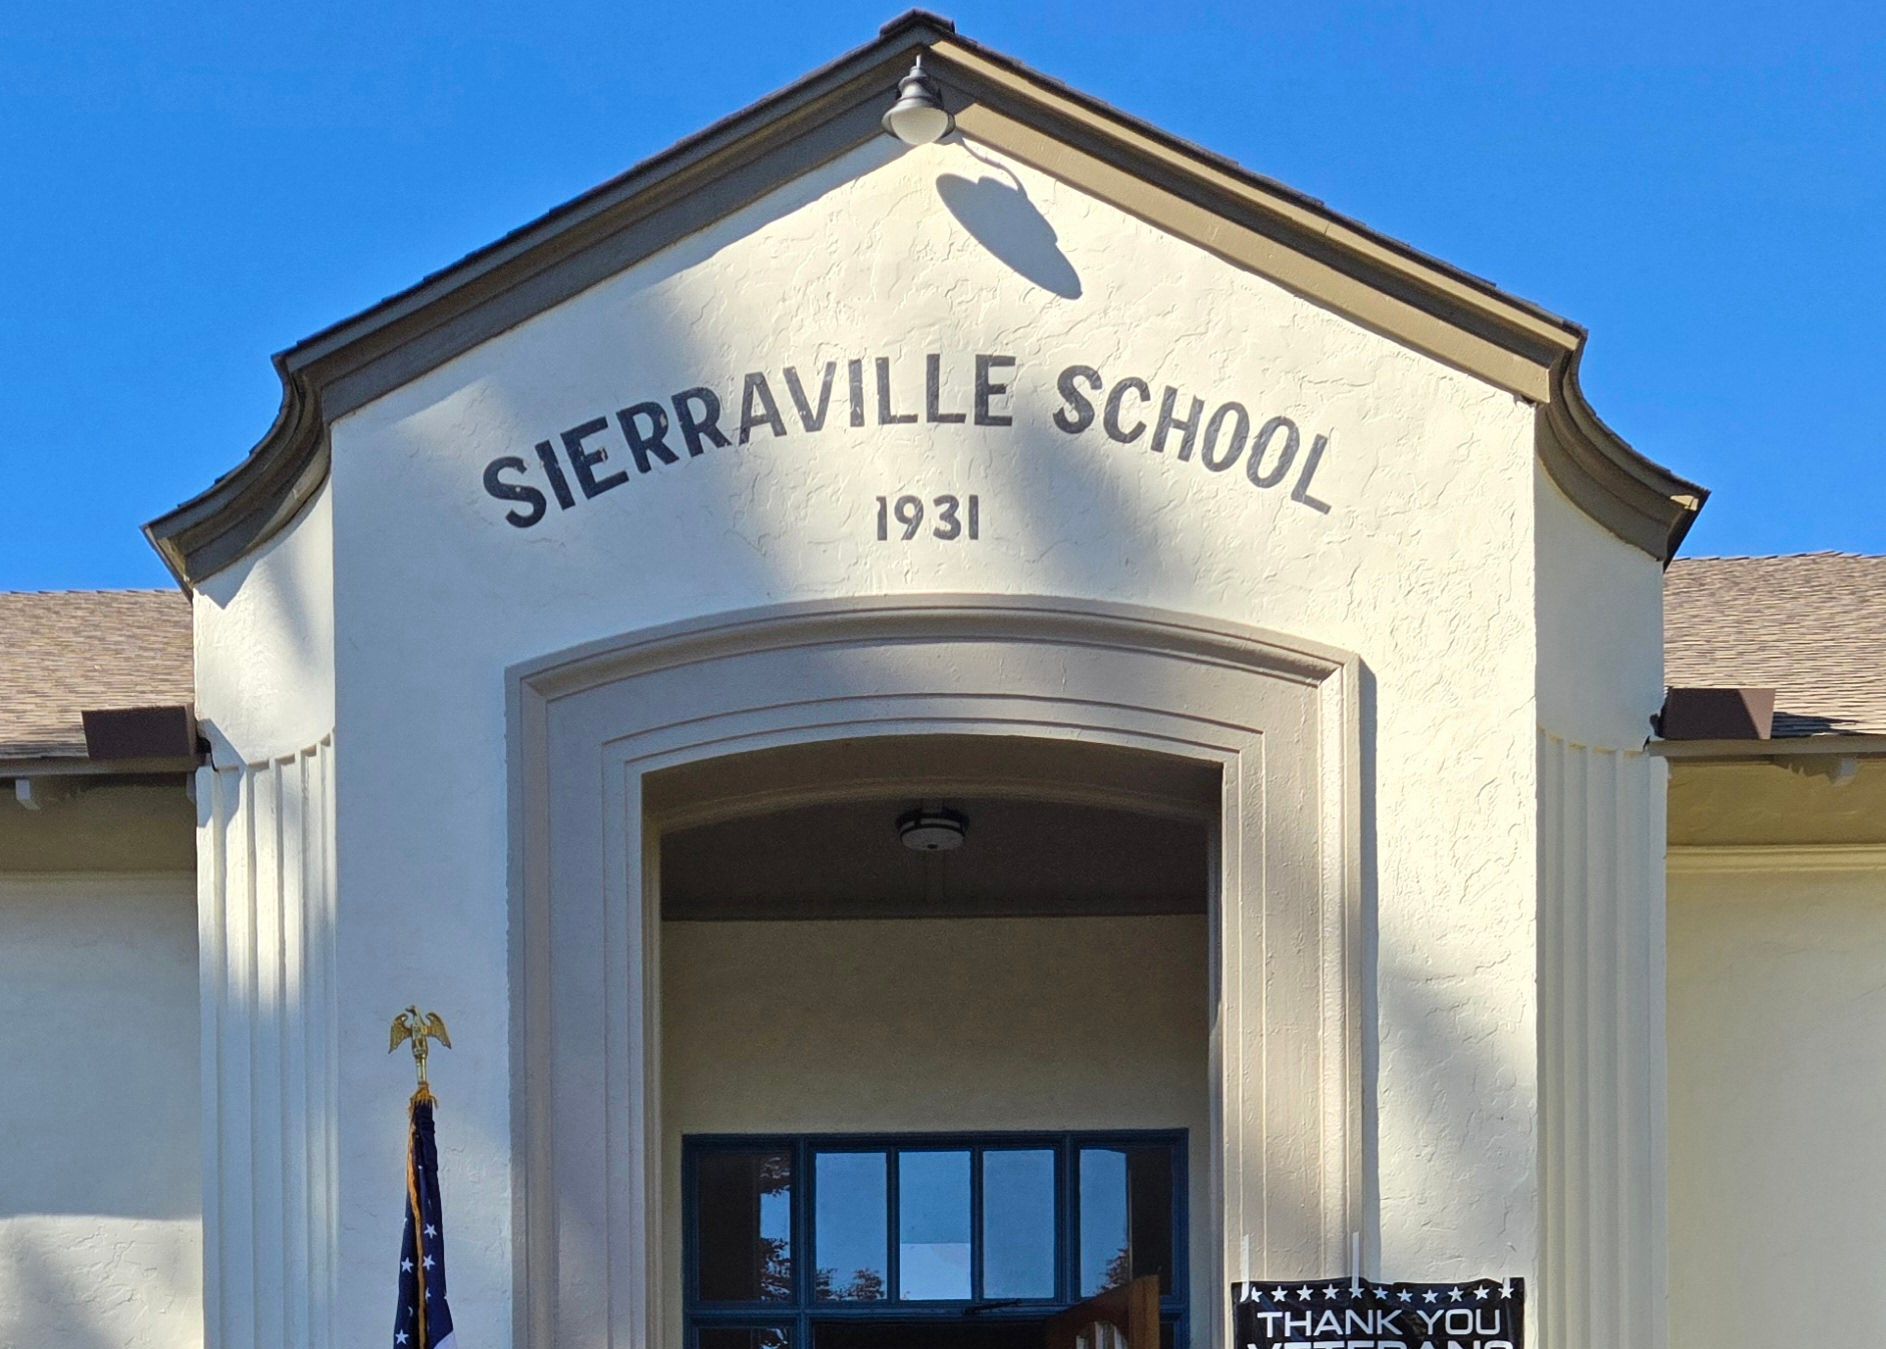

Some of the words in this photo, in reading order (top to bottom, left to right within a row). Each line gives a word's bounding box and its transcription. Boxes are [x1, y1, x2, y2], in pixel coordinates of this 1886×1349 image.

[484, 354, 1017, 529] SIERRAVILLE
[1052, 363, 1333, 515] SCHOOL
[876, 495, 980, 541] 1931
[1257, 1309, 1403, 1336] THANK
[1417, 1308, 1501, 1335] YOU
